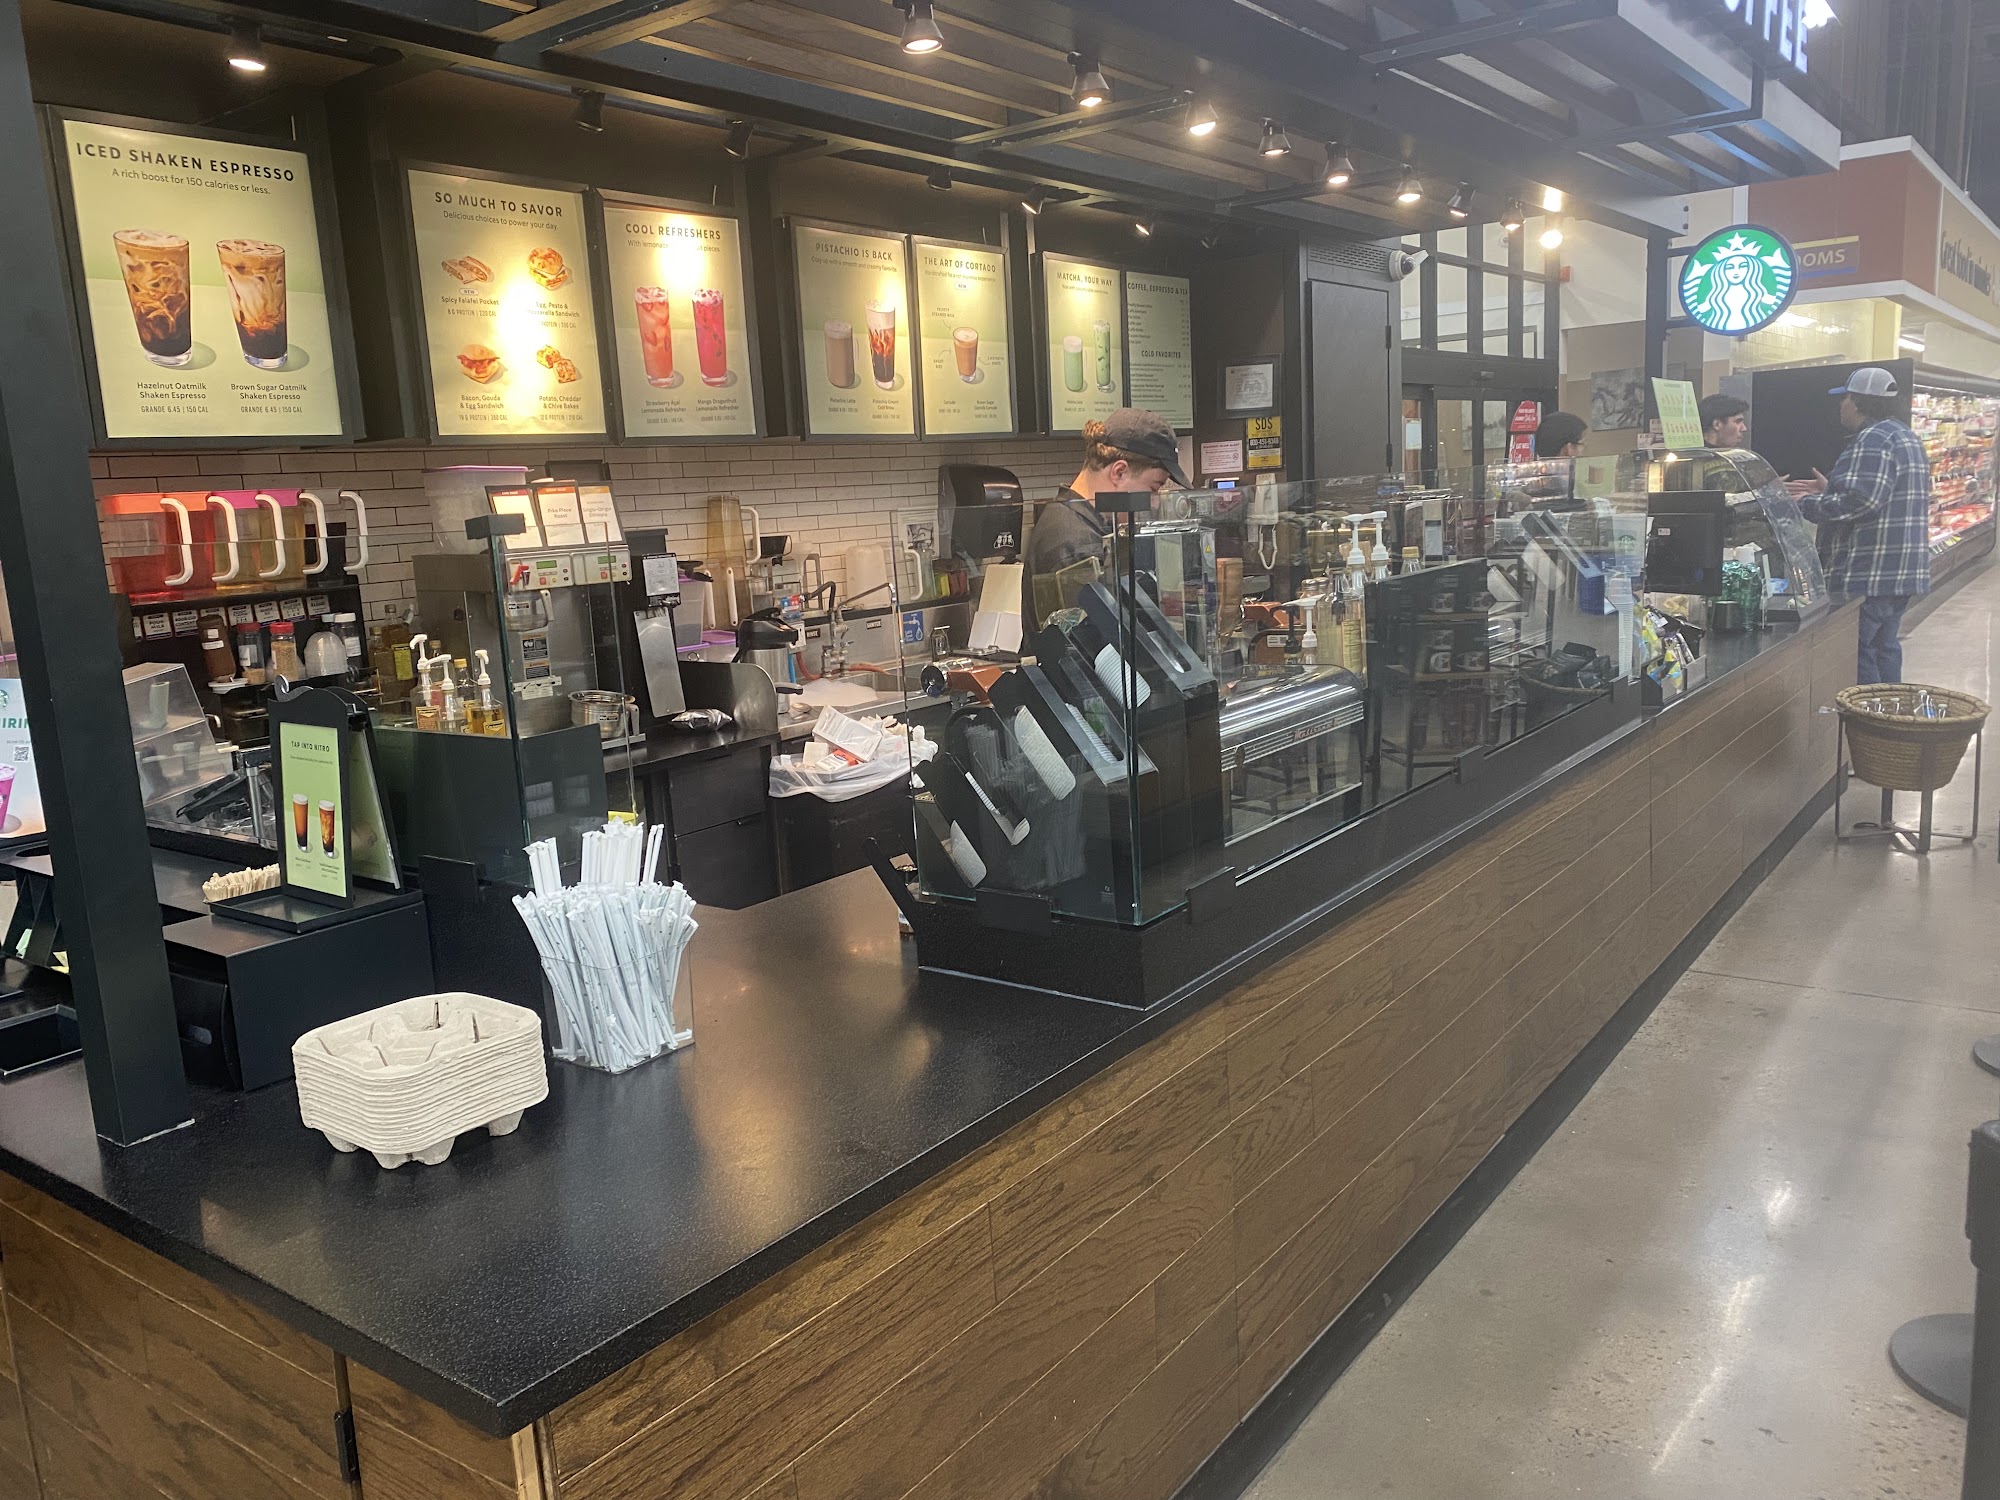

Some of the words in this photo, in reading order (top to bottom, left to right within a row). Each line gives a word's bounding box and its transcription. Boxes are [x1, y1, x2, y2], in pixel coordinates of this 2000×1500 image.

[76, 142, 121, 160] ICED
[129, 149, 202, 170] SHAKEN
[210, 159, 294, 182] ESPRESSO
[112, 168, 120, 177] A
[121, 169, 140, 179] rich
[141, 171, 169, 183] boost
[170, 174, 184, 185] for
[187, 176, 203, 187] 150
[204, 180, 239, 191] calories
[252, 184, 271, 195] less.
[434, 191, 453, 204] SO
[458, 194, 497, 210] MUCH
[500, 200, 517, 212] TO
[521, 203, 563, 217] SAVOR
[443, 210, 475, 221] Delicious
[475, 213, 500, 224] choices
[508, 219, 529, 228] power
[529, 221, 545, 230] your
[545, 222, 559, 231] day.
[625, 223, 655, 235] COOL
[658, 225, 721, 240] REFRESHERS
[627, 239, 641, 247] With
[642, 240, 669, 249] lemona
[815, 242, 860, 257] PISTACHIO
[862, 249, 870, 258] IS
[872, 250, 893, 261] BACK
[1798, 248, 1847, 268] OMS
[924, 256, 938, 266] THE
[939, 258, 953, 268] ART
[954, 260, 964, 268] OF
[965, 261, 996, 273] CORTADO
[1056, 271, 1083, 283] MATCHA,
[1084, 275, 1099, 285] YOUR
[1100, 278, 1113, 287] WAY
[1149, 284, 1174, 294] ESPRESSO
[441, 295, 458, 305] Spicy
[458, 296, 479, 304] Falafel
[479, 298, 500, 306] Pocket
[548, 301, 564, 309] Pesto
[555, 310, 580, 318] Sandwich
[1141, 350, 1155, 358] COLD
[1155, 350, 1182, 359] FAVORITES
[137, 381, 174, 390] Hazelnut
[175, 382, 207, 390] Oatmilk
[230, 383, 255, 391] Brown
[256, 383, 278, 392] Sugar
[139, 391, 170, 399] Shaken
[171, 391, 207, 400] Espresso
[239, 392, 268, 400] Shaken
[268, 392, 301, 401] Espresso
[460, 394, 482, 402] Bacon,
[538, 395, 559, 403] Potato,
[140, 405, 166, 413] GRANDE
[167, 405, 181, 413] 6.45
[186, 405, 197, 413] 150
[197, 405, 209, 413] CAL
[465, 402, 477, 410] Egg
[1255, 417, 1273, 431] SDS
[291, 740, 301, 748] TAP
[300, 742, 313, 750] INTO
[313, 743, 330, 753] NITRO
